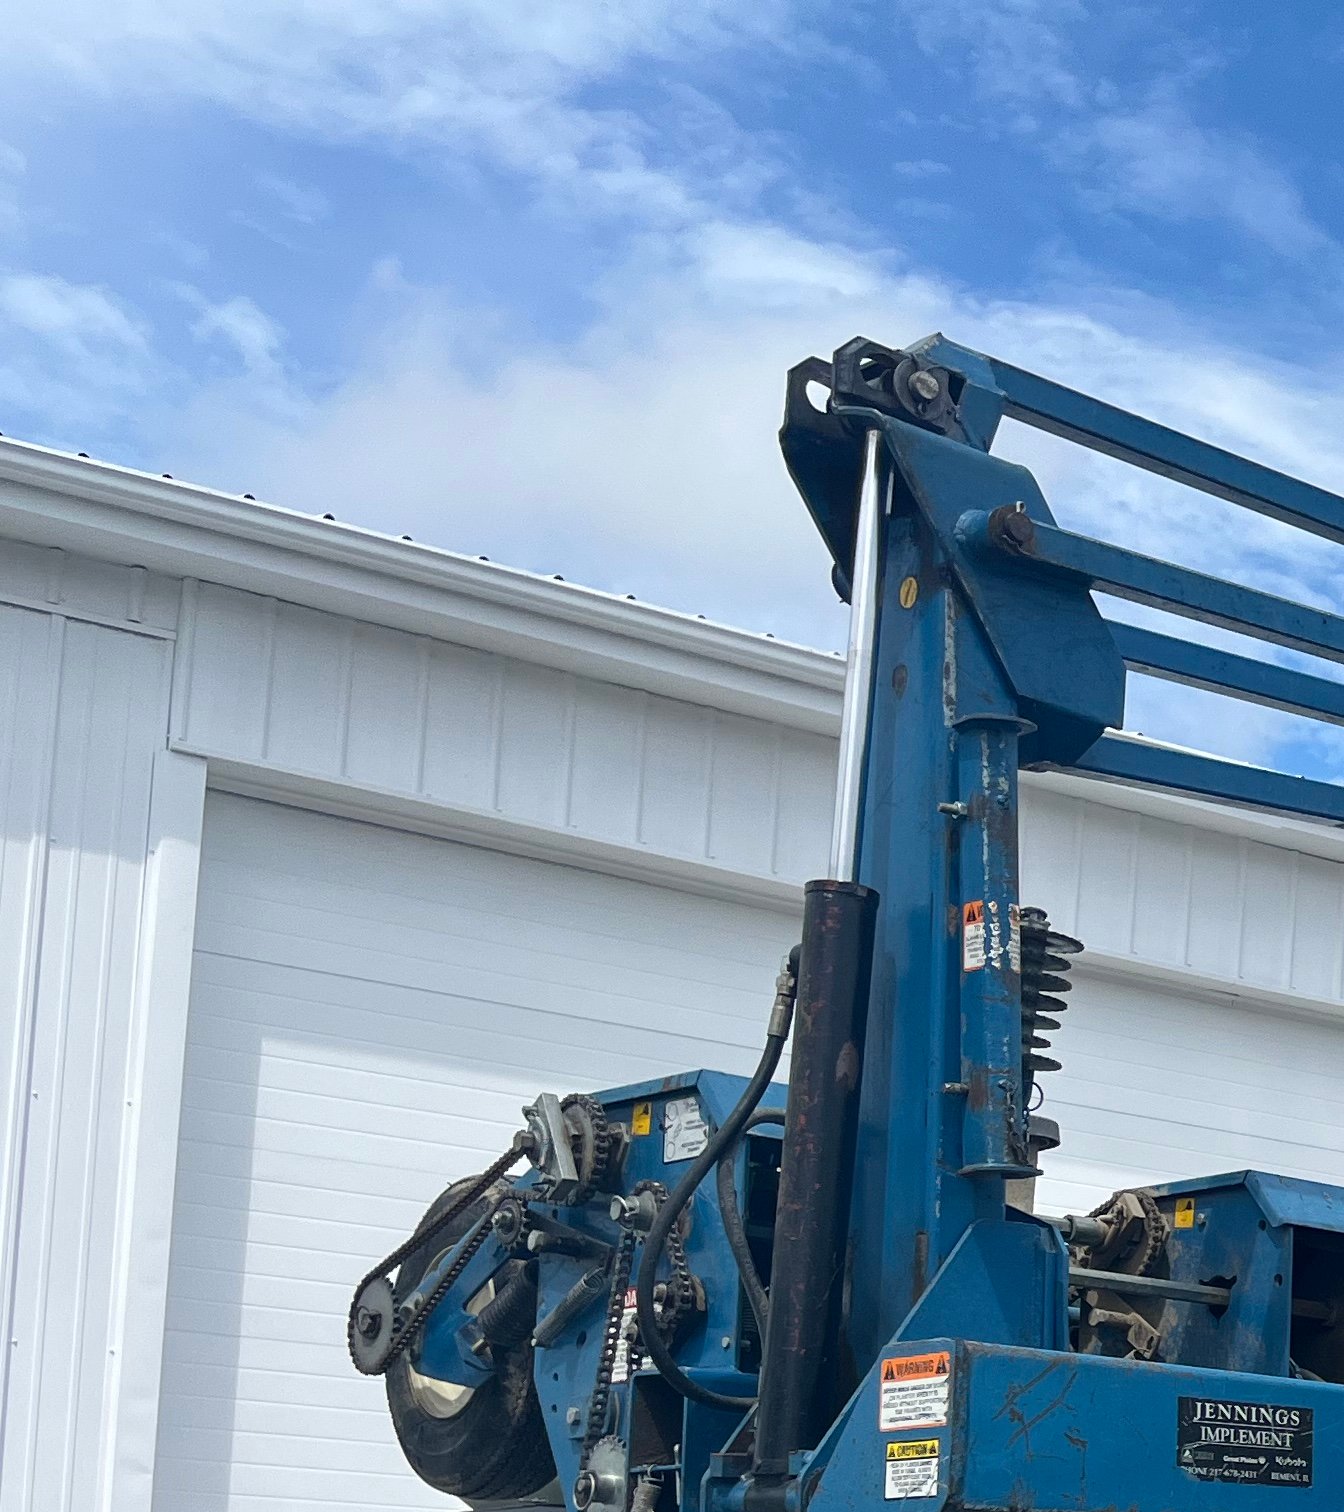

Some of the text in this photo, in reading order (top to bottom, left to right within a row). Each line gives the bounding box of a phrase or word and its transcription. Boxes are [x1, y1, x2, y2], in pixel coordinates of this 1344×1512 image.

[895, 1360, 934, 1377] WARNING
[1193, 1402, 1300, 1426] JENNINGS
[1200, 1426, 1294, 1448] IMPLEMENT
[896, 1444, 928, 1457] CAUTION
[1275, 1456, 1307, 1467] Kubota
